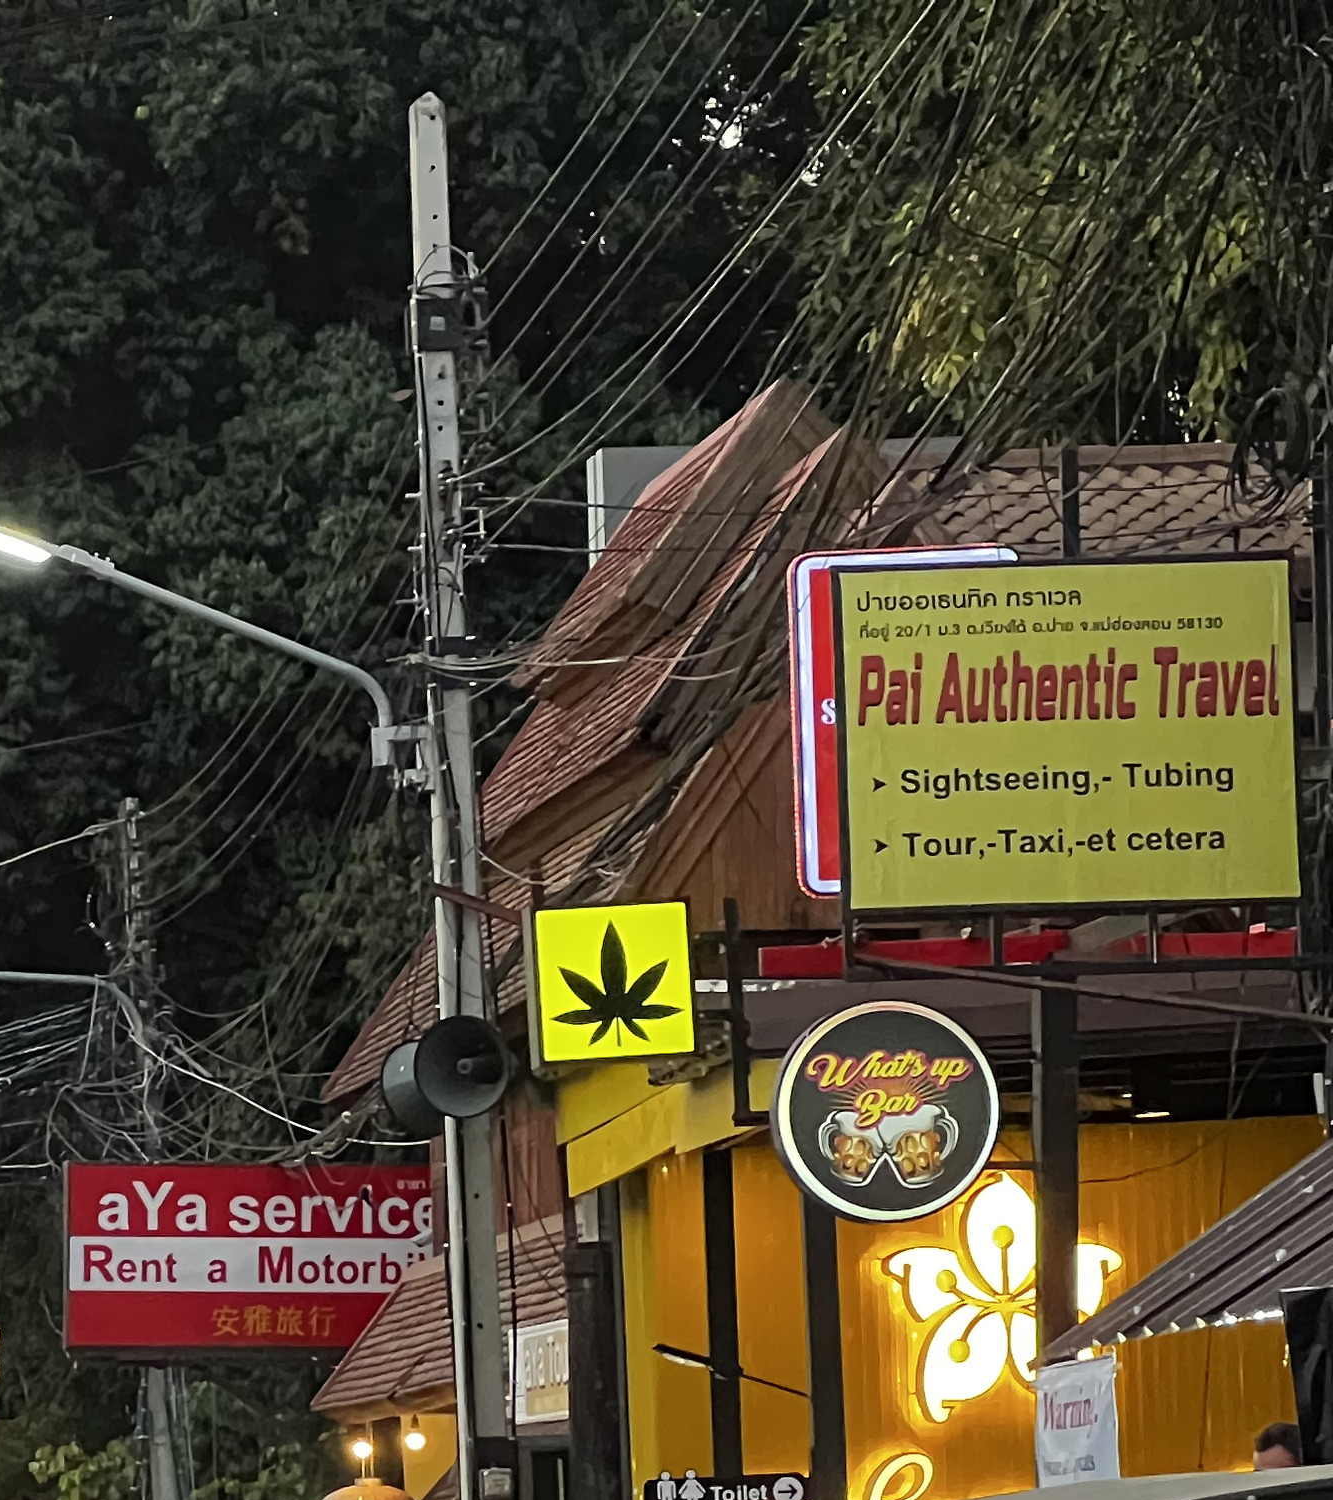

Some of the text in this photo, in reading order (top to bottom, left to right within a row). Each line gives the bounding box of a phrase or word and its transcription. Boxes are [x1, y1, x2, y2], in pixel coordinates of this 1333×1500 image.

[895, 623, 931, 638] 20/1
[1177, 616, 1224, 630] 58130
[857, 643, 1280, 727] Pai Authentic Travel
[1122, 762, 1235, 792] Tubing
[1127, 827, 1226, 852] cetera
[807, 1049, 970, 1088] What's up
[855, 1088, 918, 1128] Bar
[98, 1180, 208, 1232] aYa
[83, 1244, 426, 1285] Rent a Motorb
[211, 1304, 336, 1338] 安雅旅行
